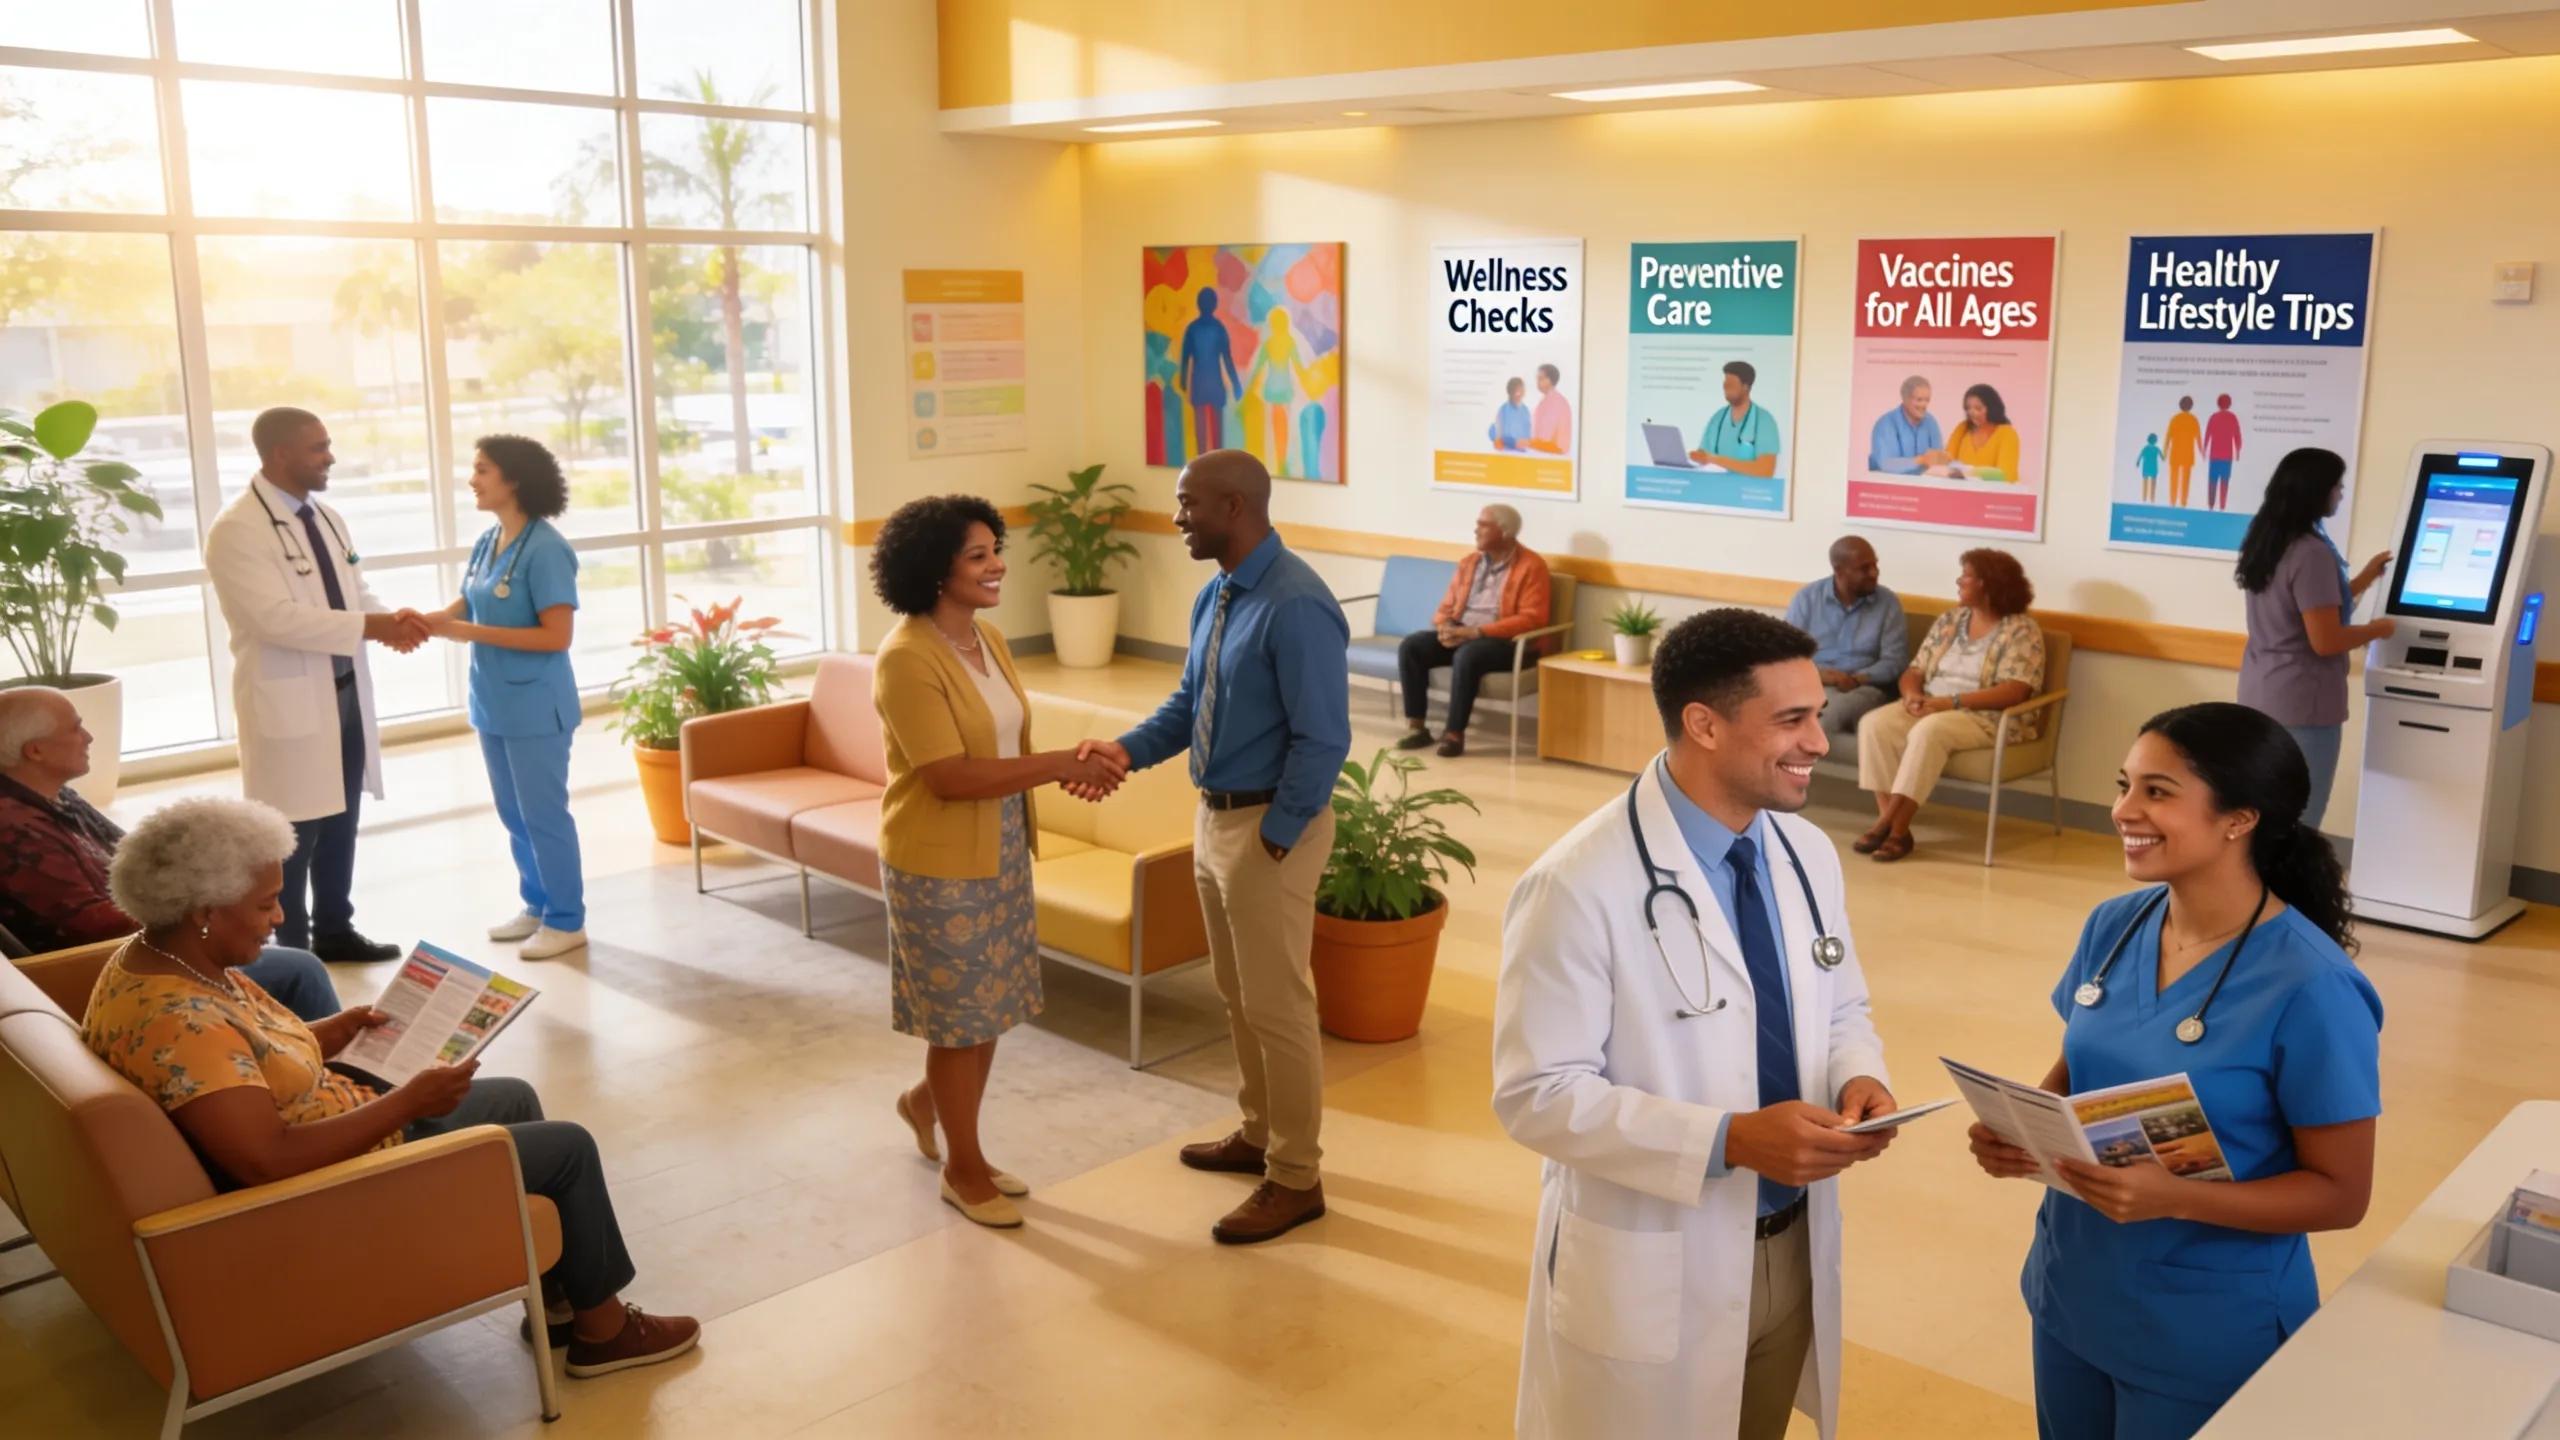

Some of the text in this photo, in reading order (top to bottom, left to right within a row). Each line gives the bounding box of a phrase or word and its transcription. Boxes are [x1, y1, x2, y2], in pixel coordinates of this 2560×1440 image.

[1443, 257, 1568, 293] Wellness
[1640, 254, 1784, 289] Preventive
[1879, 253, 2014, 288] Vaccines
[2149, 249, 2280, 295] Healthy
[1448, 296, 1554, 334] Checks
[1647, 293, 1712, 327] Care
[1864, 291, 2037, 337] for All Ages
[2139, 292, 2354, 340] Lifestyle Tips
